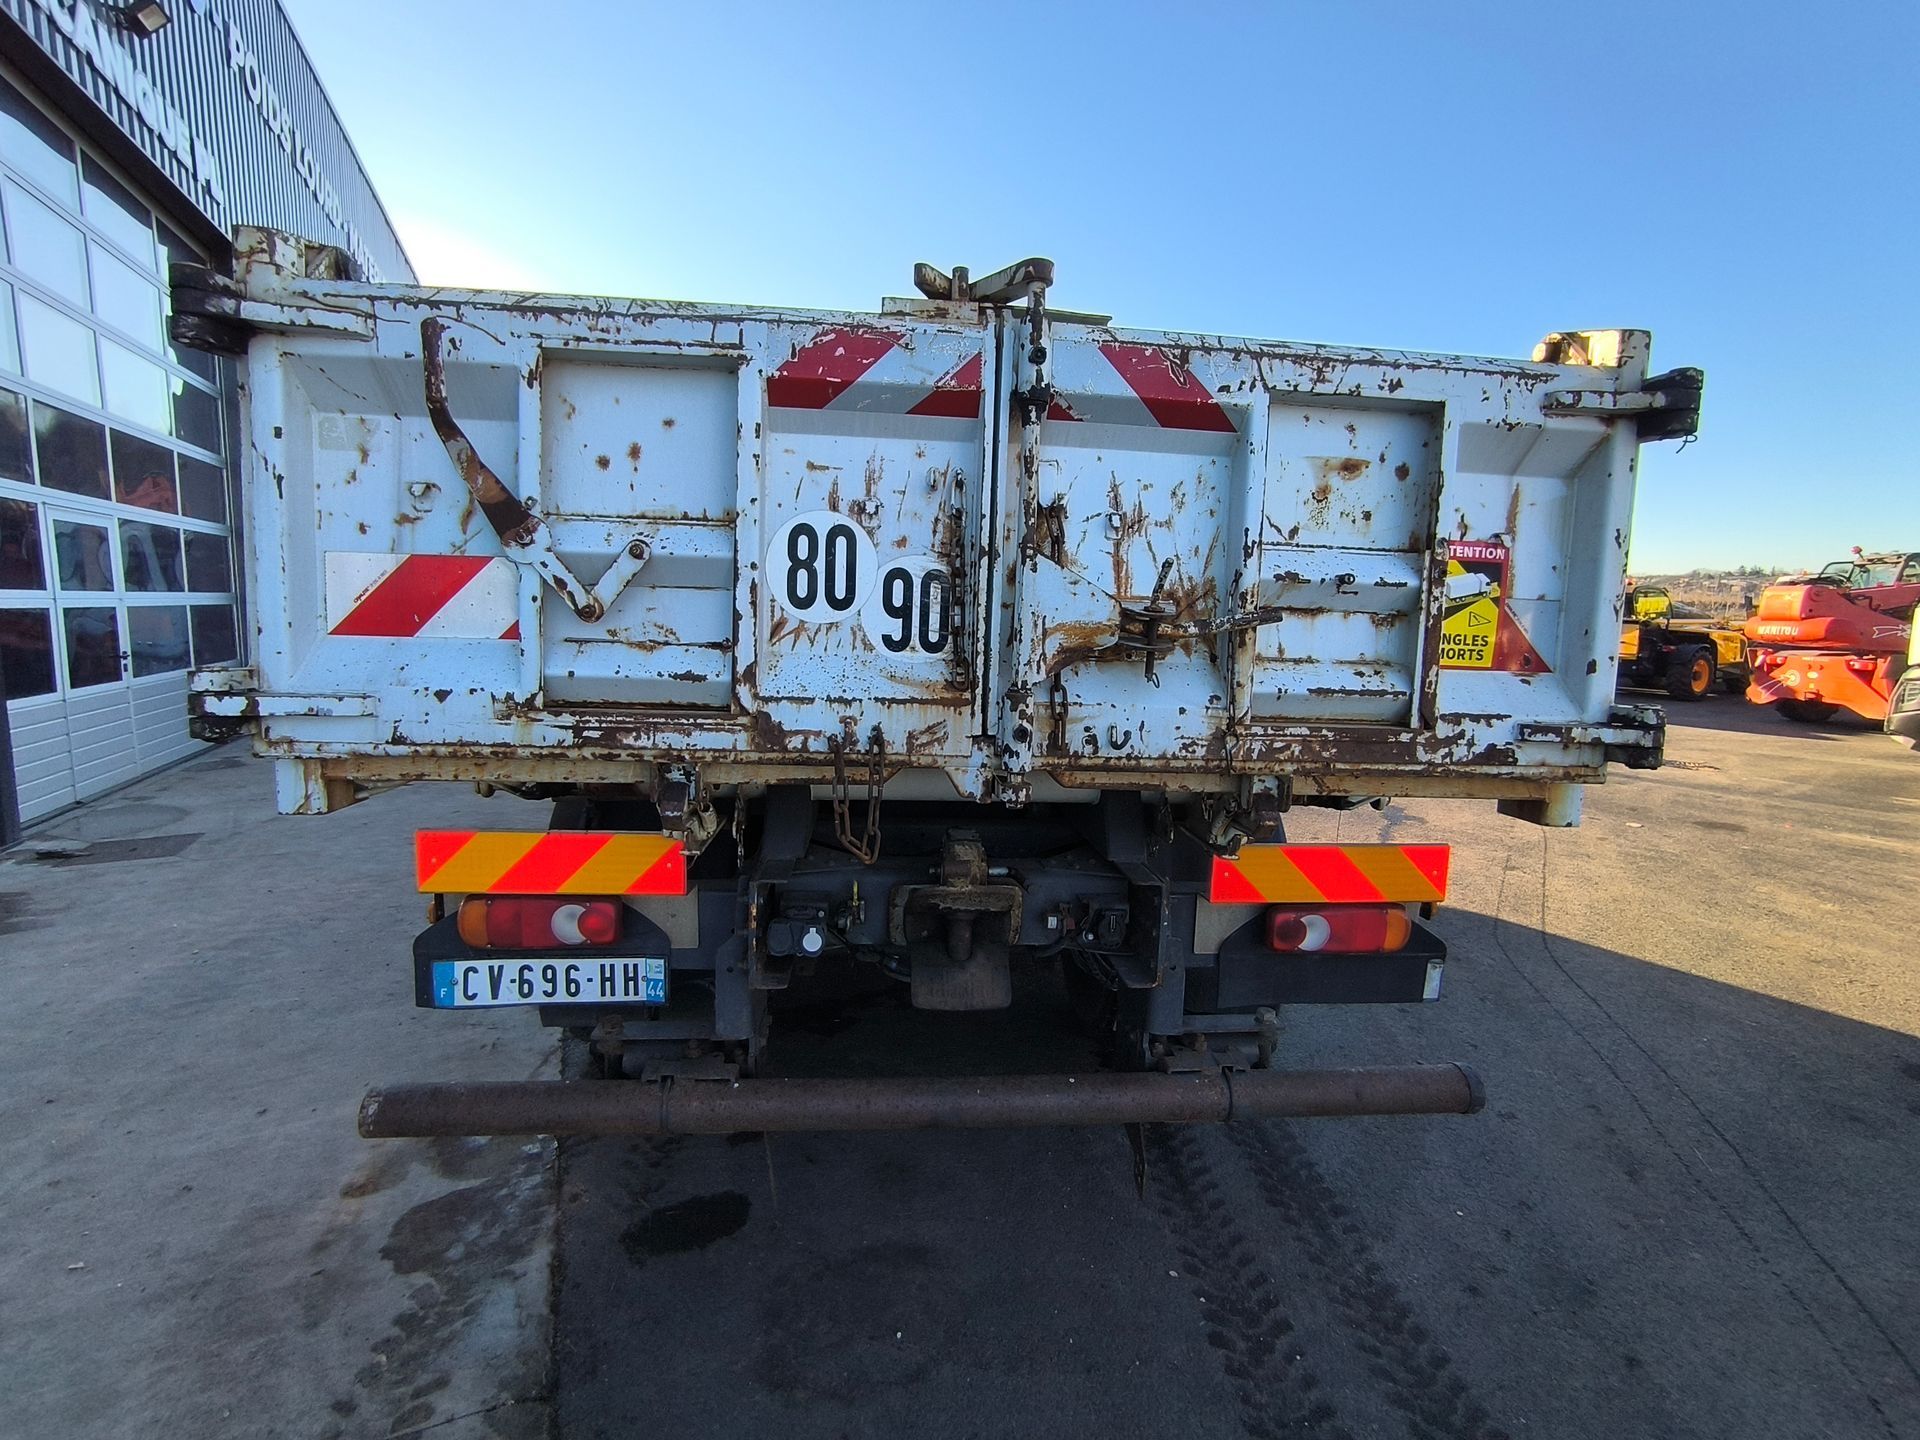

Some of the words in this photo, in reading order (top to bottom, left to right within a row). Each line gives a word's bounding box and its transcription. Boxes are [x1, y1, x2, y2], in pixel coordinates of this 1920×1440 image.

[229, 20, 292, 153] POIDS
[787, 522, 857, 611] 80
[881, 567, 950, 654] 90
[1757, 625, 1799, 635] MANITOU
[440, 988, 447, 998] F
[462, 963, 640, 1001] CV-696-HH
[647, 981, 664, 998] 44
